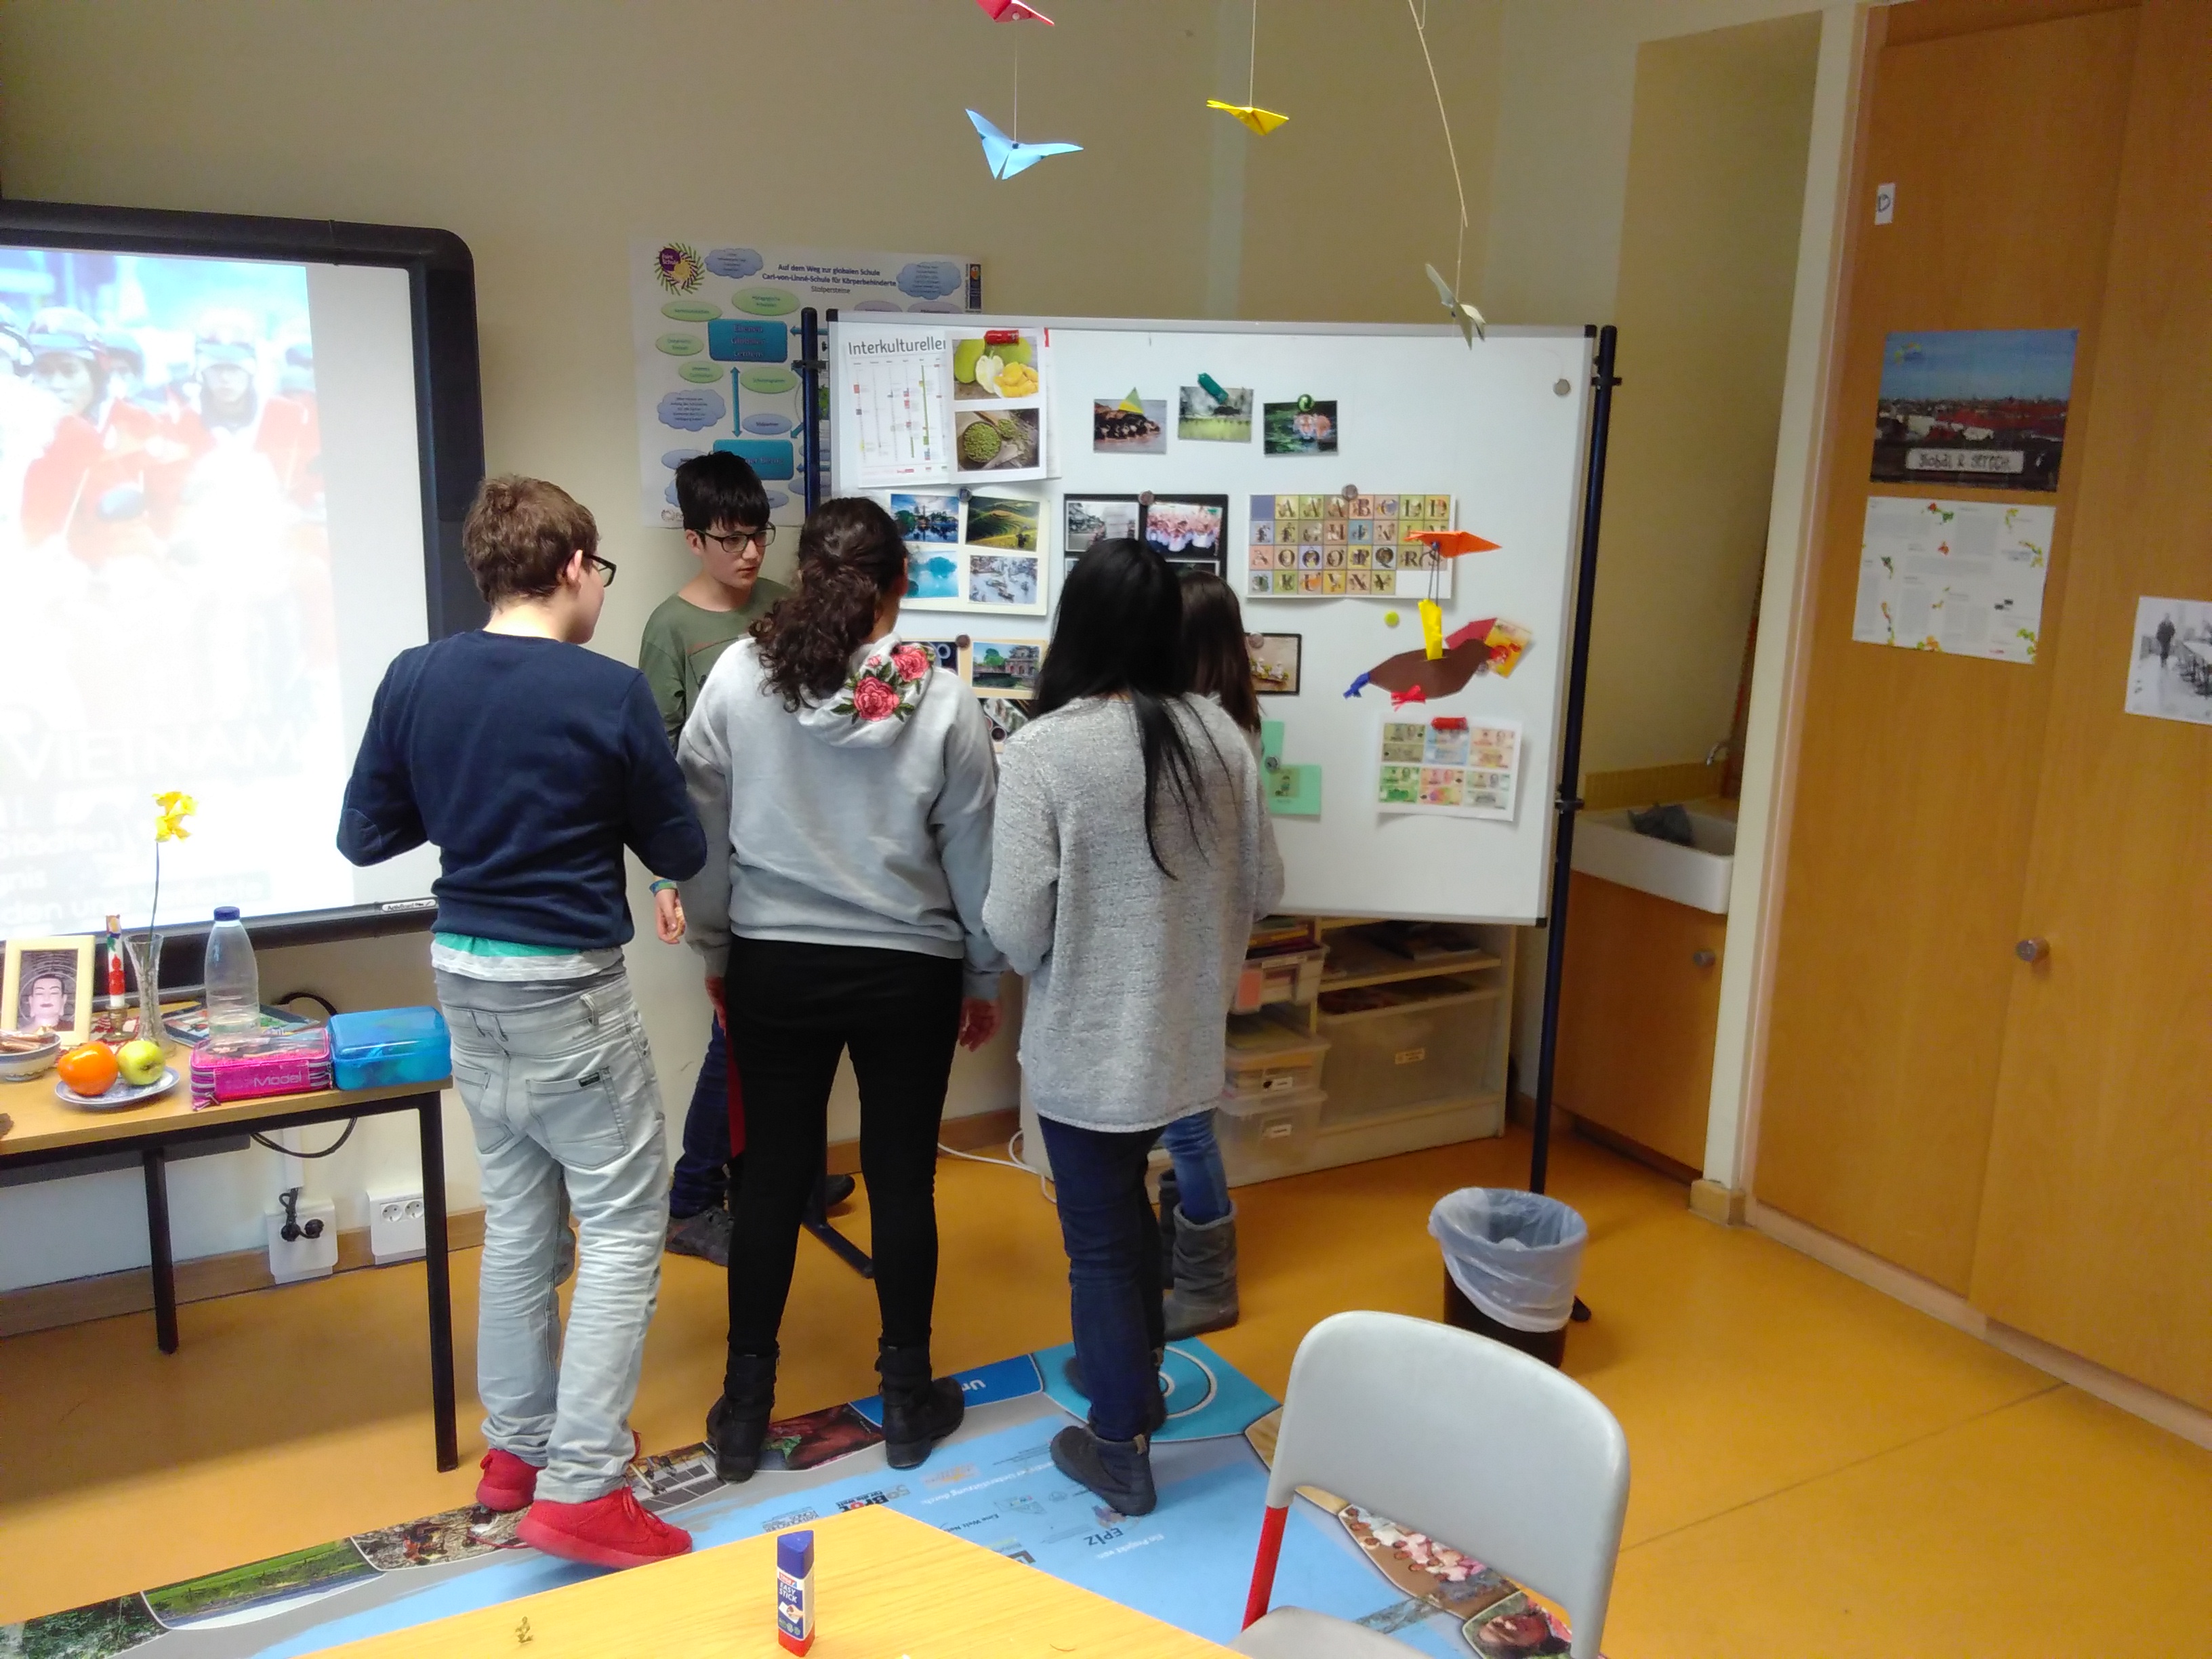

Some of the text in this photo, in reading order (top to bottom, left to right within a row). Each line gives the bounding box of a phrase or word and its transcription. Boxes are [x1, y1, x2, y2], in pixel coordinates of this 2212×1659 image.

[806, 266, 821, 274] Weg
[842, 278, 897, 287] Körperbehinderte
[811, 285, 851, 294] Stolpersteine
[4, 721, 303, 781] VIETNAM
[779, 1582, 796, 1595] EASY
[779, 1589, 798, 1603] STICK
